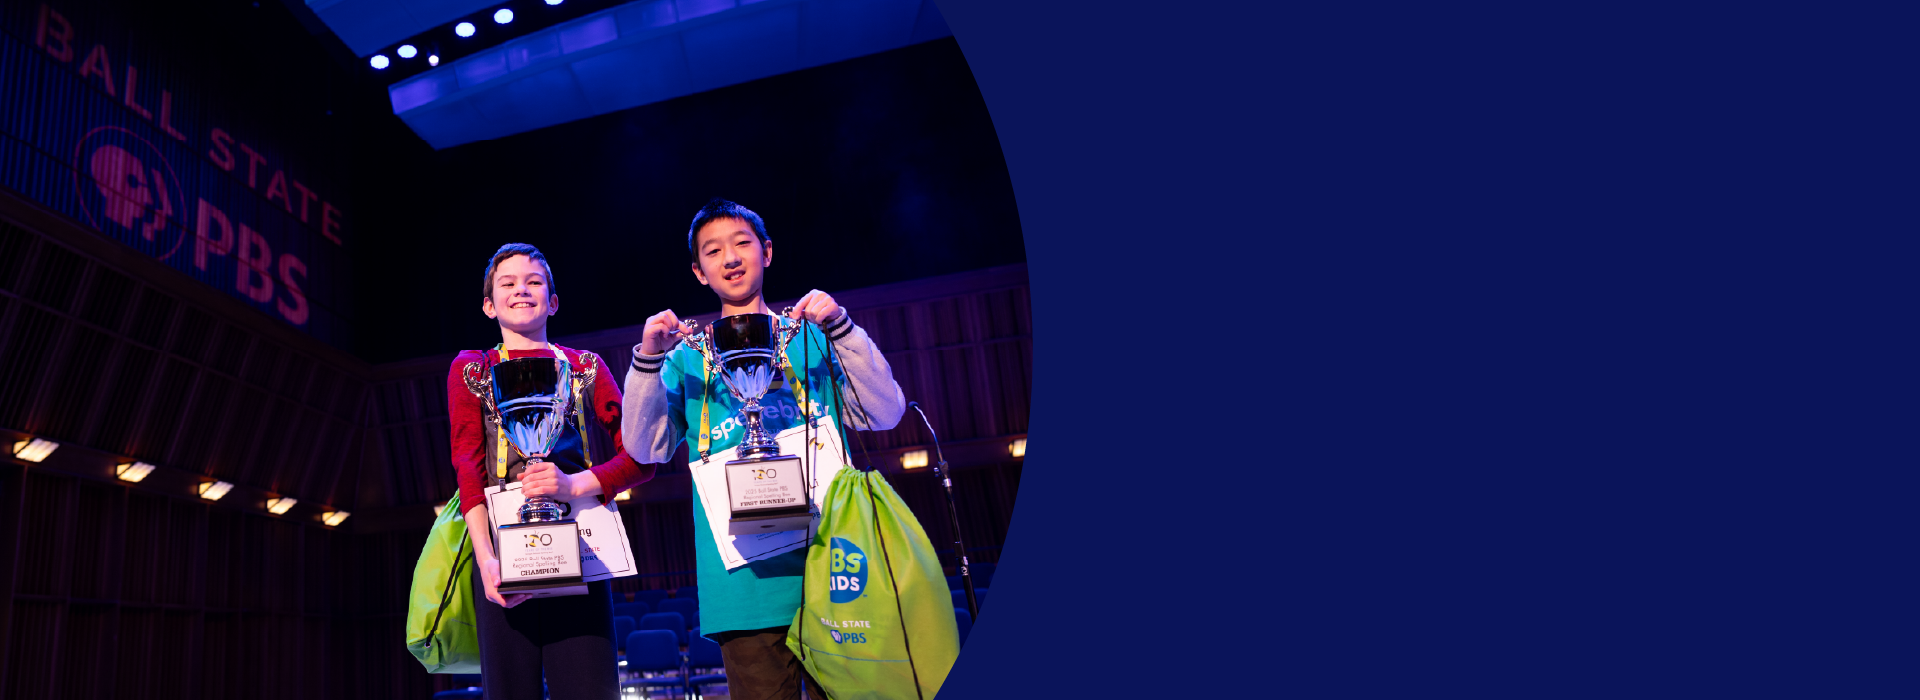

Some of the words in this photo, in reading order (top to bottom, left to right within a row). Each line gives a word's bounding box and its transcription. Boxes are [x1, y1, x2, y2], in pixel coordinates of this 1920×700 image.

[36, 4, 187, 141] BALL
[208, 127, 342, 247] STATE
[193, 197, 310, 325] PBS
[830, 548, 864, 574] BS
[520, 567, 560, 576] CHAMPION
[820, 617, 839, 628] BALL
[842, 620, 871, 628] STATE
[843, 632, 867, 644] PBS
